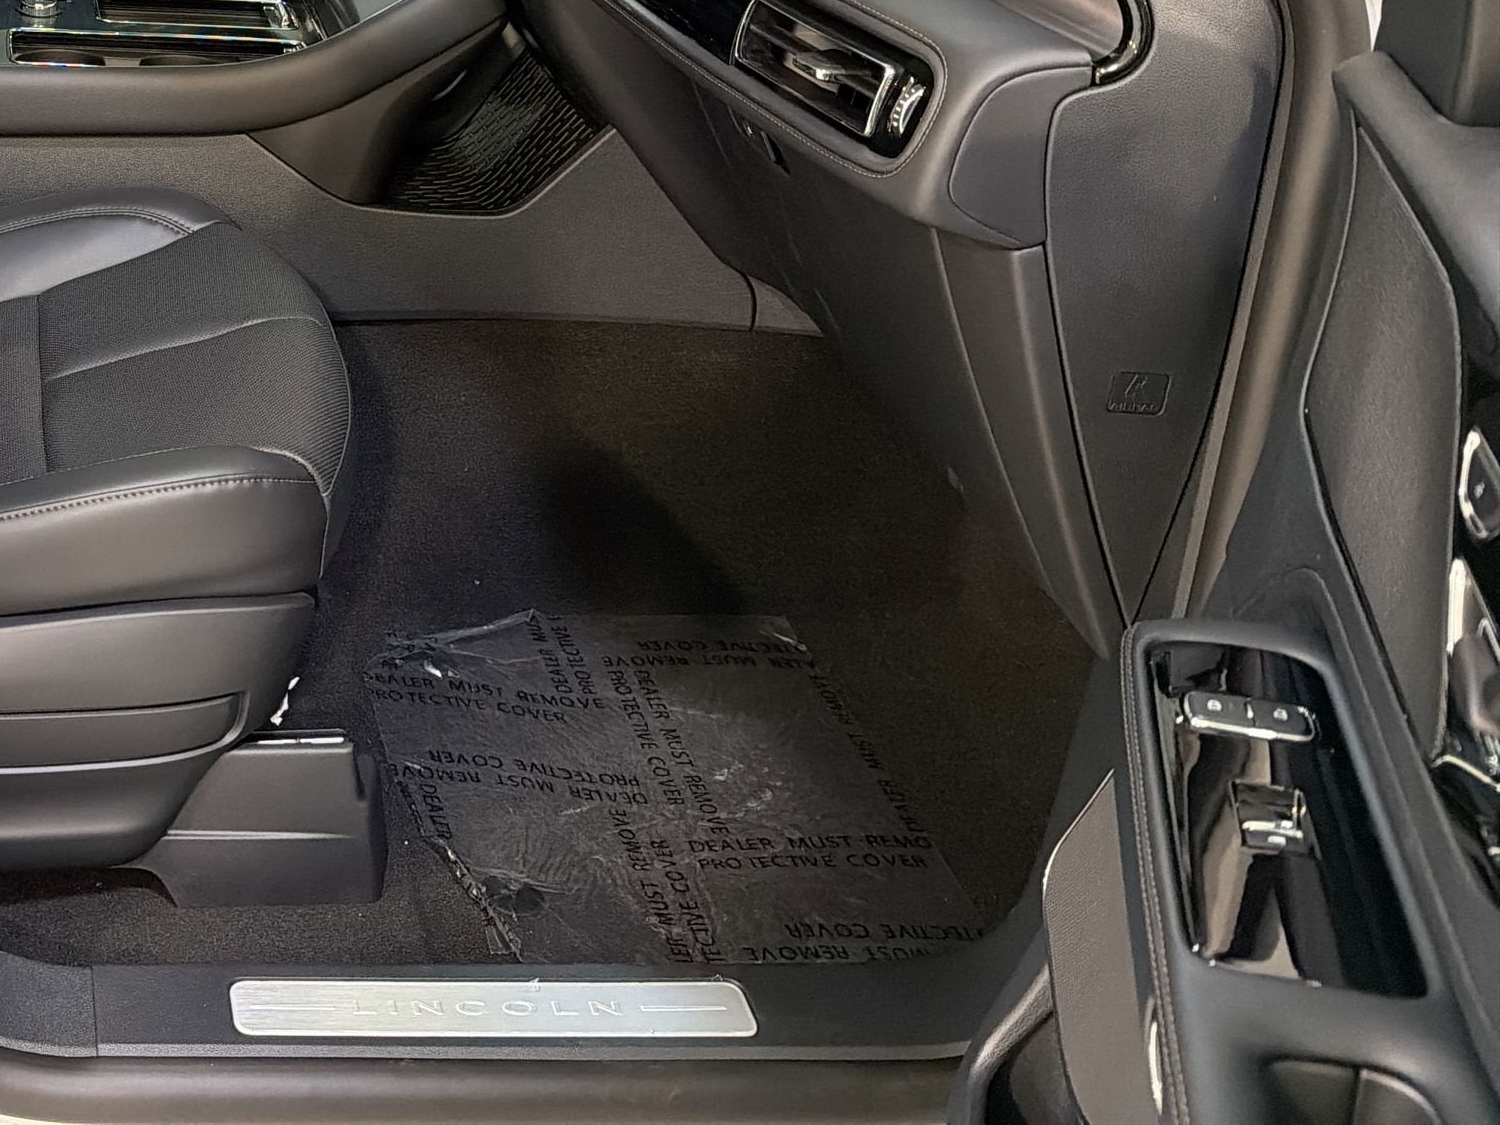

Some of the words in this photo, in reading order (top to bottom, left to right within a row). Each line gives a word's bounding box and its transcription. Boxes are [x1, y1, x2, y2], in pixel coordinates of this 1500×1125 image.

[449, 679, 502, 698] MUST
[517, 690, 606, 710] REMOVE
[496, 702, 568, 724] COVER
[607, 669, 659, 750] PROTECTIVE
[647, 756, 685, 806] COVER
[427, 749, 504, 769] COVER
[633, 669, 670, 721] DEALER
[660, 727, 695, 768] MUST
[683, 774, 731, 836] REMOVE
[516, 759, 640, 787] PROTECTIVE
[497, 775, 554, 794] MUST
[568, 784, 648, 806] DEALER
[608, 809, 651, 872] REMOVE
[687, 837, 775, 853] DEALER
[788, 835, 852, 852] MUST
[650, 839, 690, 894] COVER
[698, 853, 837, 870] PROTECTIVE
[846, 853, 929, 868] COVER
[640, 880, 677, 926] MUST
[784, 923, 870, 940] COVER
[743, 944, 850, 962] REMOVE
[352, 999, 623, 1017] LINCOLN
